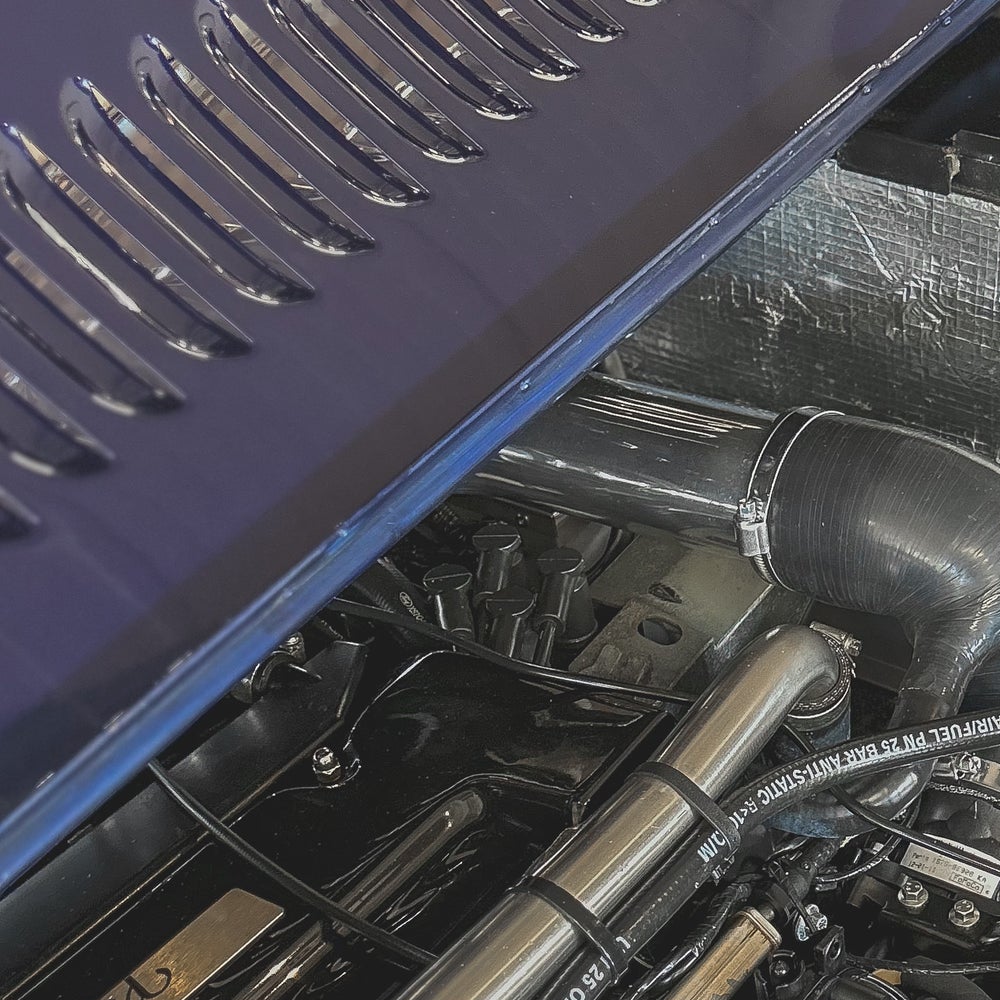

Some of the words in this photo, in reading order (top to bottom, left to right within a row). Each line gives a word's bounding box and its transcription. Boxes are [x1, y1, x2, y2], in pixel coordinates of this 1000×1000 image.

[879, 736, 900, 755] 25
[903, 730, 926, 750] PN
[844, 742, 878, 765] BAR
[755, 752, 845, 806] ANTI-STATIC
[579, 962, 606, 990] 25
